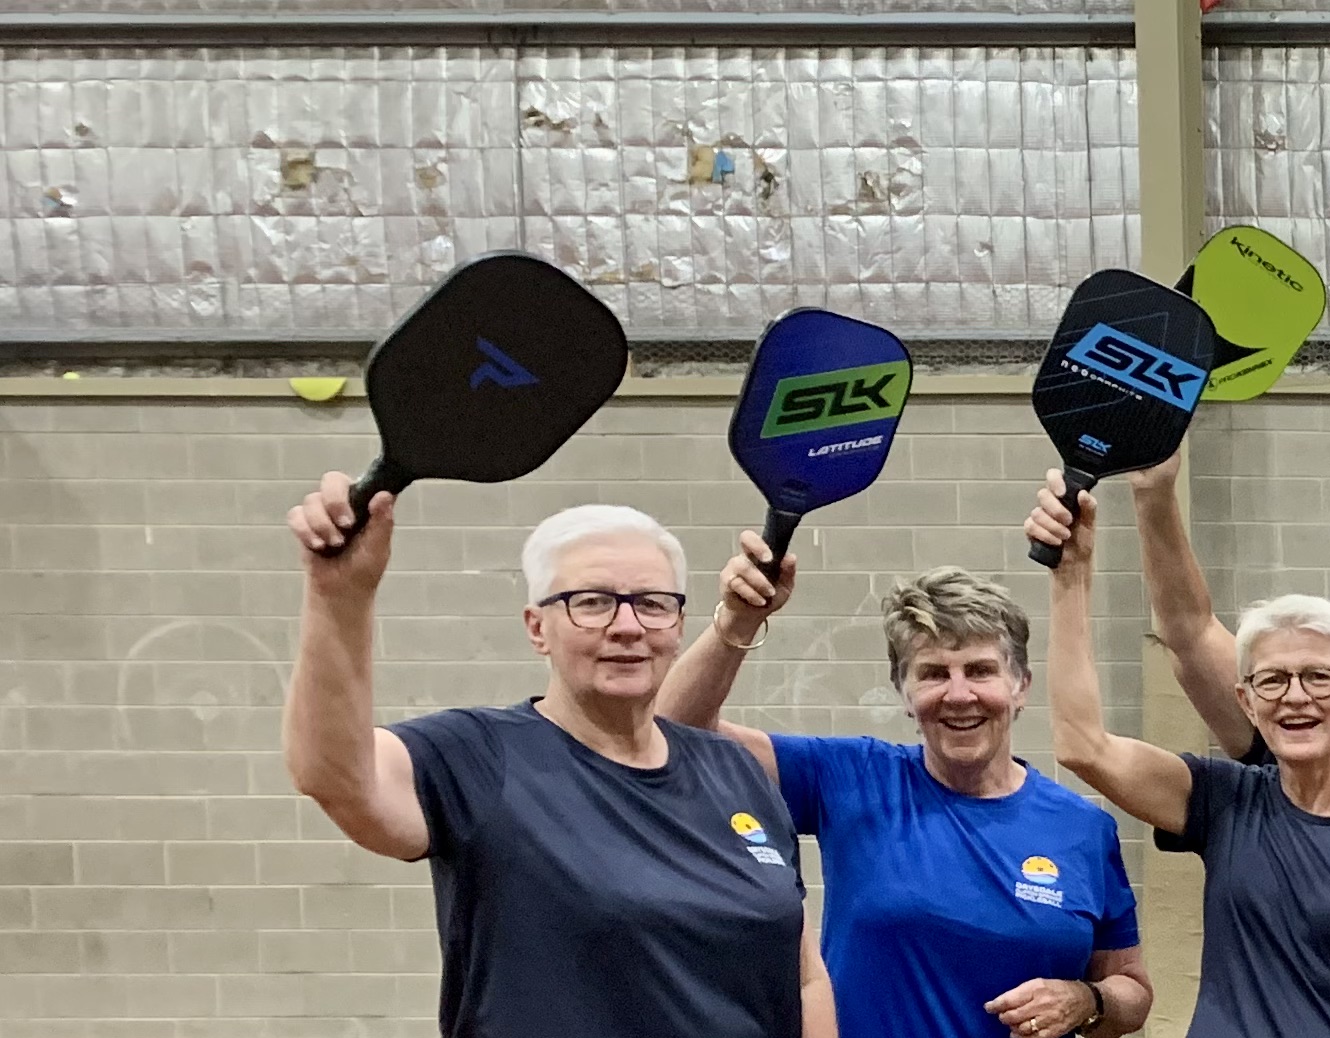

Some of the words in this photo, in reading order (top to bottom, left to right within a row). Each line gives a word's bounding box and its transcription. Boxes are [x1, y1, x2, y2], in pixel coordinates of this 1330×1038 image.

[1084, 335, 1201, 401] SLK
[776, 373, 897, 426] SLK
[807, 434, 884, 457] LATITUDE
